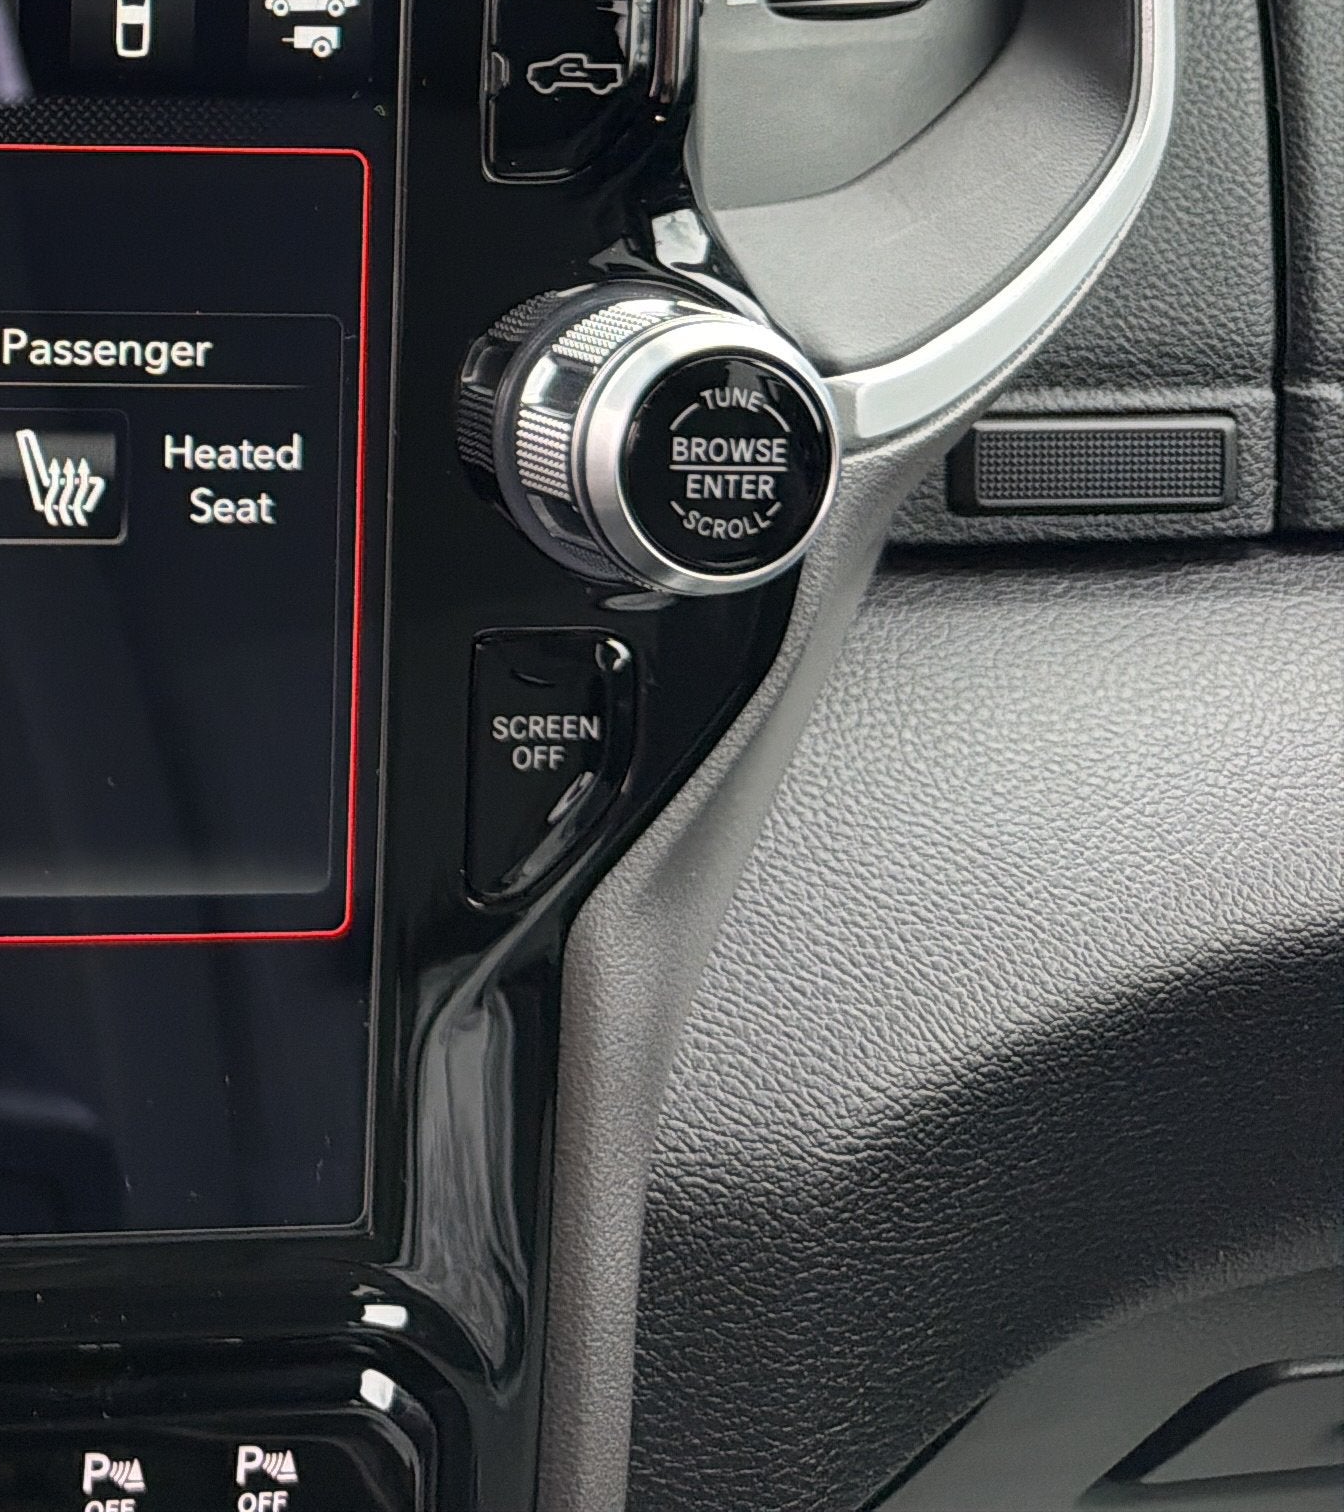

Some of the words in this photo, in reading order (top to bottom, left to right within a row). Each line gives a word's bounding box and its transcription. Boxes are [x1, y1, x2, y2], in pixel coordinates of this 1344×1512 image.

[2, 328, 214, 376] Passenger
[700, 386, 764, 412] TUNE
[163, 432, 303, 471] Heated
[671, 436, 788, 465] BROWSE
[685, 472, 776, 501] ENTER
[188, 486, 275, 525] Seat
[682, 510, 772, 540] SCROLL
[492, 715, 600, 741] SCREEN
[512, 745, 565, 771] OFF
[237, 1490, 289, 1512] OFF
